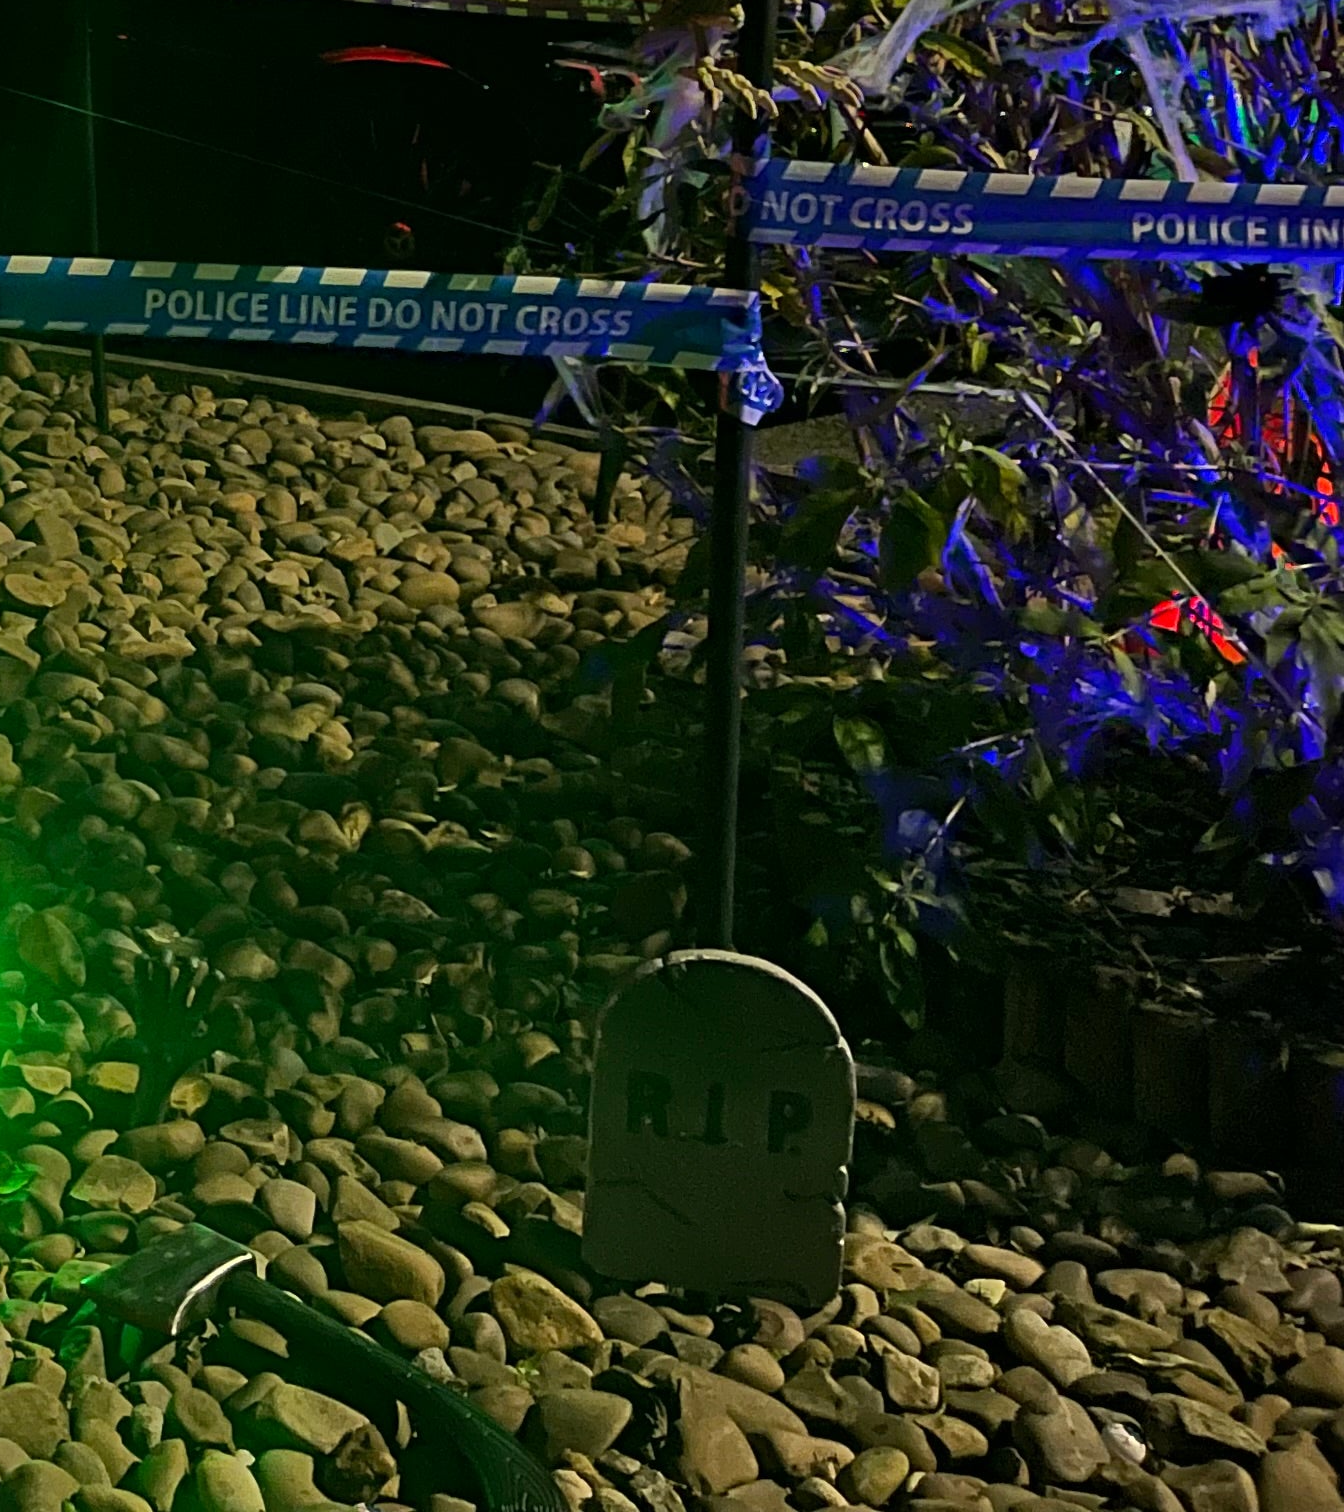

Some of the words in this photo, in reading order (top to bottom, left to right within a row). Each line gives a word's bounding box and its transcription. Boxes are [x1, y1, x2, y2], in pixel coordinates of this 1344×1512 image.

[759, 190, 844, 226] NOT
[849, 196, 974, 236] CROSS
[1131, 211, 1270, 247] POLICE
[1275, 216, 1344, 249] LIN
[143, 288, 268, 324] POLICE
[278, 293, 358, 328] LINE
[367, 298, 422, 331] DO
[430, 299, 507, 334] NOT
[514, 304, 633, 338] CROSS
